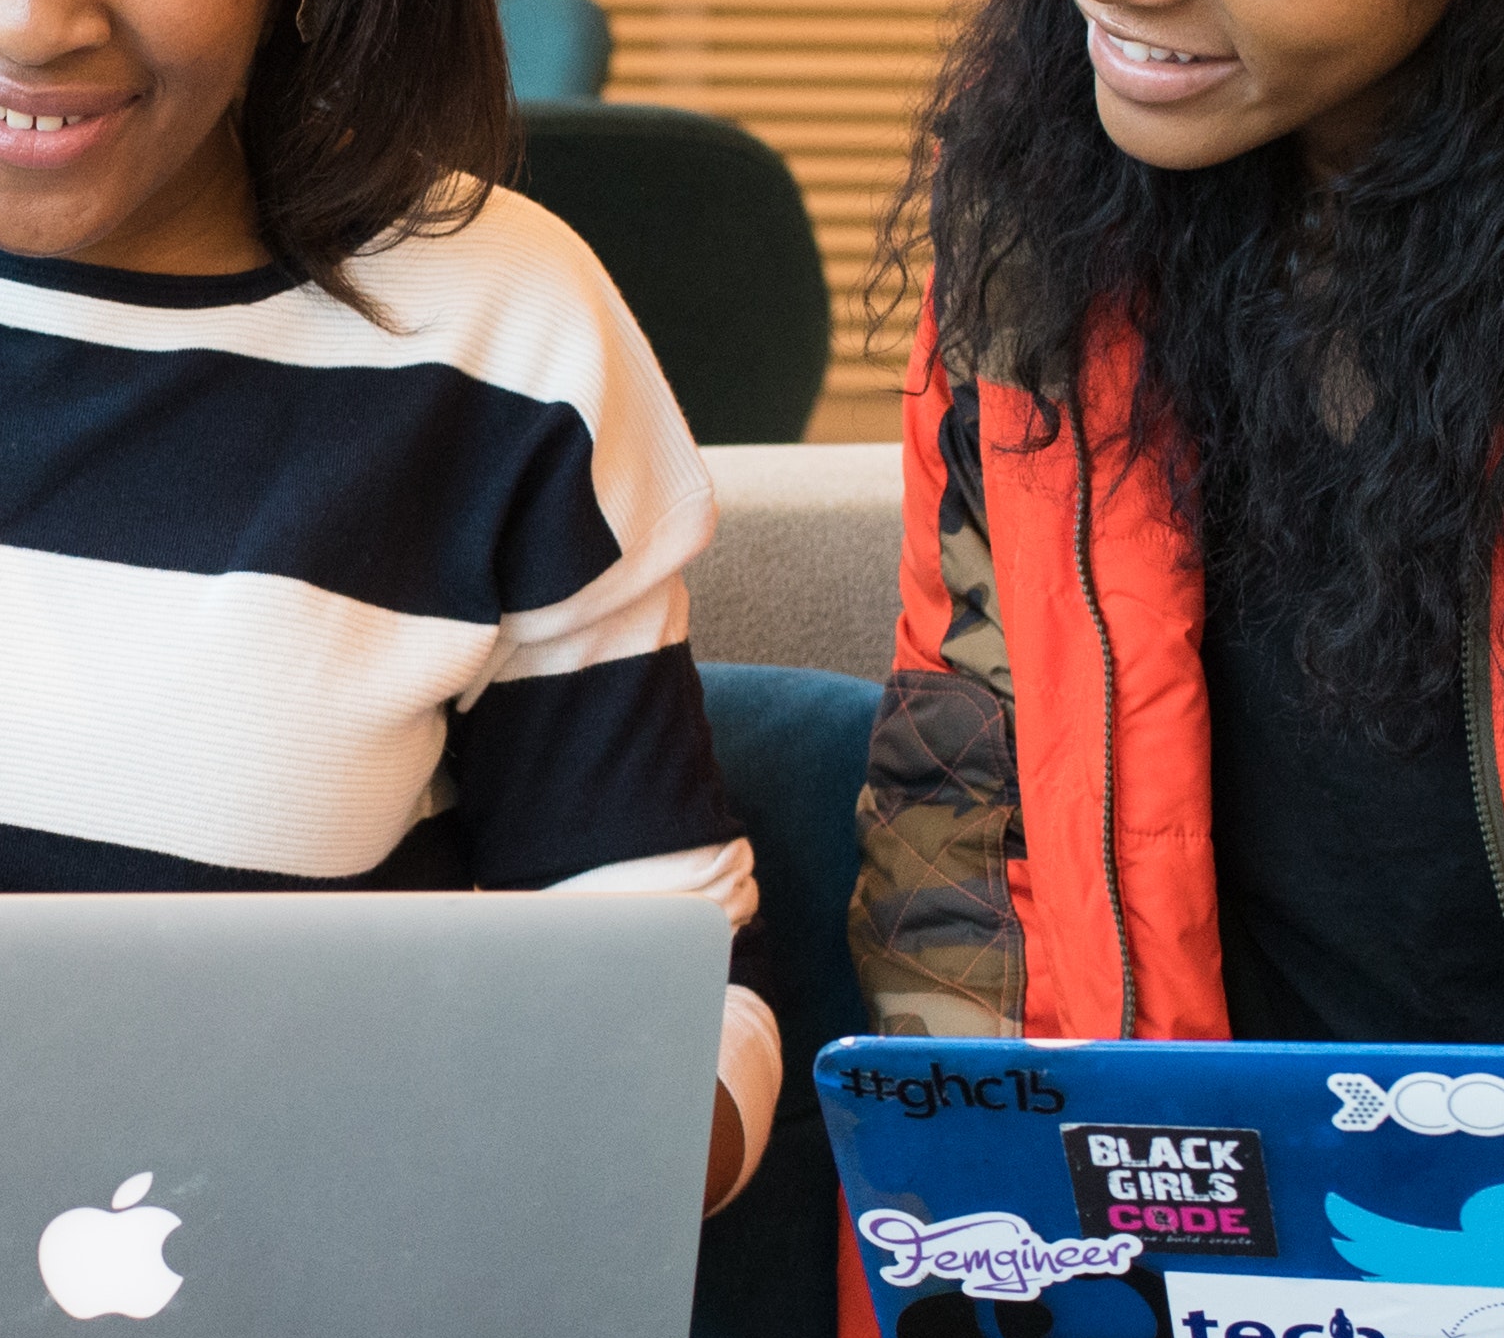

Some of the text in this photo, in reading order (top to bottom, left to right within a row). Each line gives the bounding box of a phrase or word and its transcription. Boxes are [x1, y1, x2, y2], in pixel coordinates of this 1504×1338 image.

[840, 1062, 1066, 1119] #ghc15
[1088, 1135, 1243, 1170] BLACK
[1107, 1170, 1238, 1202] GIRLS
[1108, 1205, 1250, 1234] CODE
[869, 1217, 1131, 1294] Femgineer
